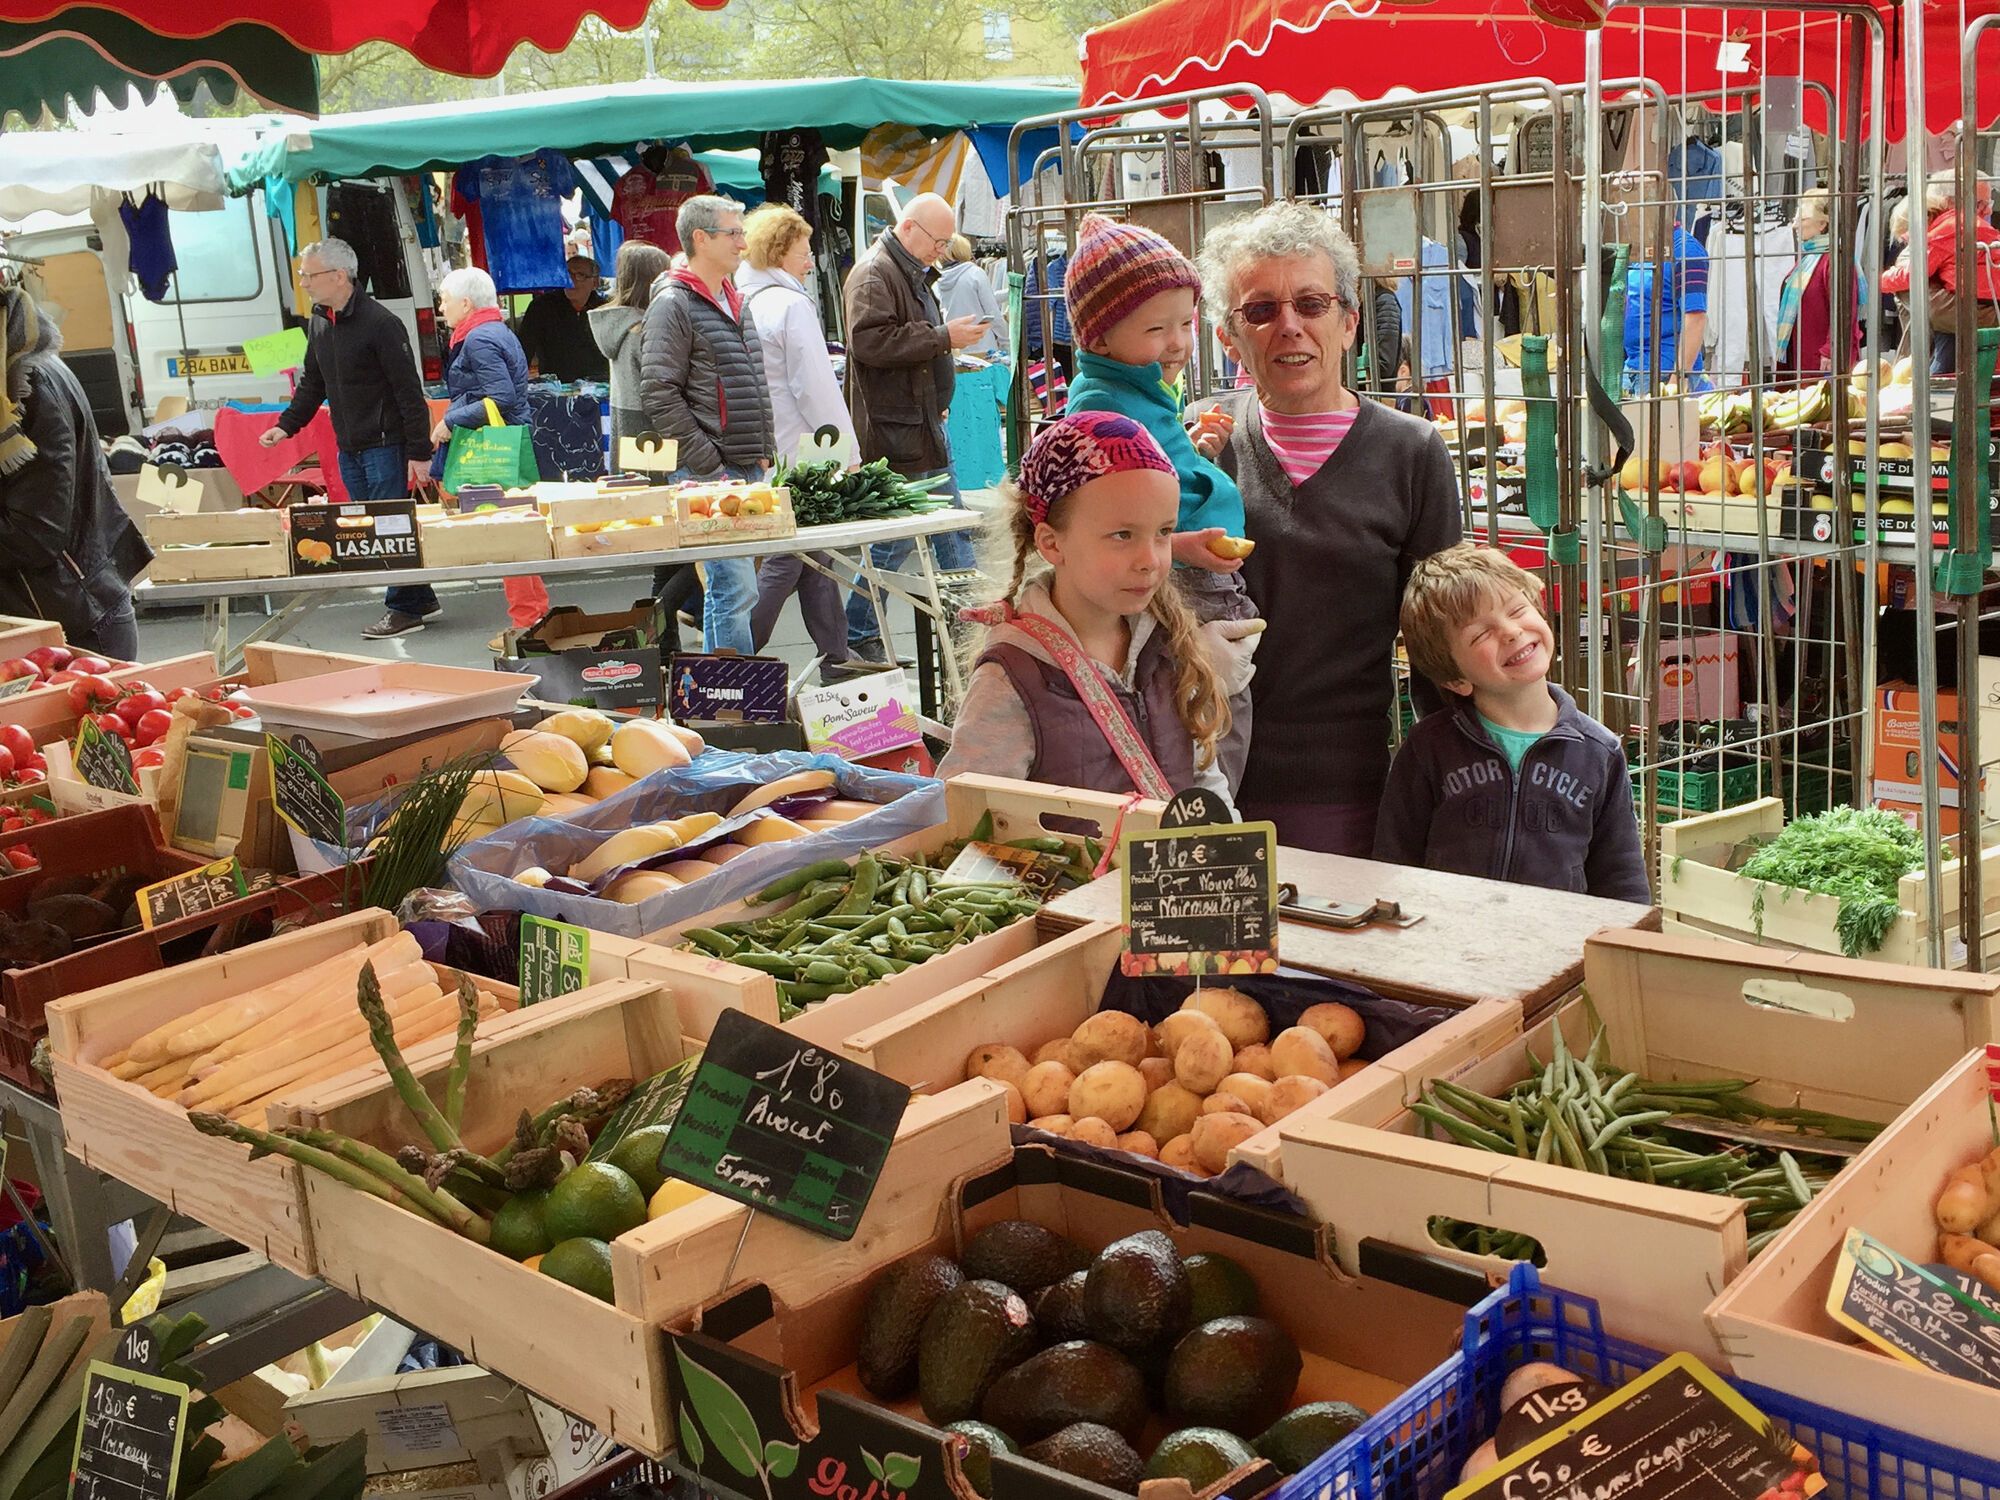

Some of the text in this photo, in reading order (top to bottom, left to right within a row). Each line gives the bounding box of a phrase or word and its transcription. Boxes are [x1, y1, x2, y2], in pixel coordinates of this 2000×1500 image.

[179, 359, 207, 374] 284
[210, 358, 237, 372] BAW
[1854, 459, 1896, 474] TERE
[1898, 463, 1909, 474] DI
[1852, 516, 1893, 530] TERE
[1896, 519, 1908, 530] DI
[336, 537, 416, 557] LASARTE
[706, 687, 744, 700] GAMIN
[298, 739, 317, 765] 1kg
[1531, 761, 1593, 808] CYCLE
[1170, 796, 1206, 825] 1kg
[745, 1093, 833, 1144] Avocat
[1853, 1280, 1889, 1309] Variété
[1856, 1269, 1891, 1296] Produit
[1850, 1292, 1885, 1319] Origine
[126, 1329, 150, 1364] 1kg
[1684, 1383, 1702, 1399] €
[1519, 1386, 1588, 1424] 1kg
[1580, 1433, 1612, 1458] €
